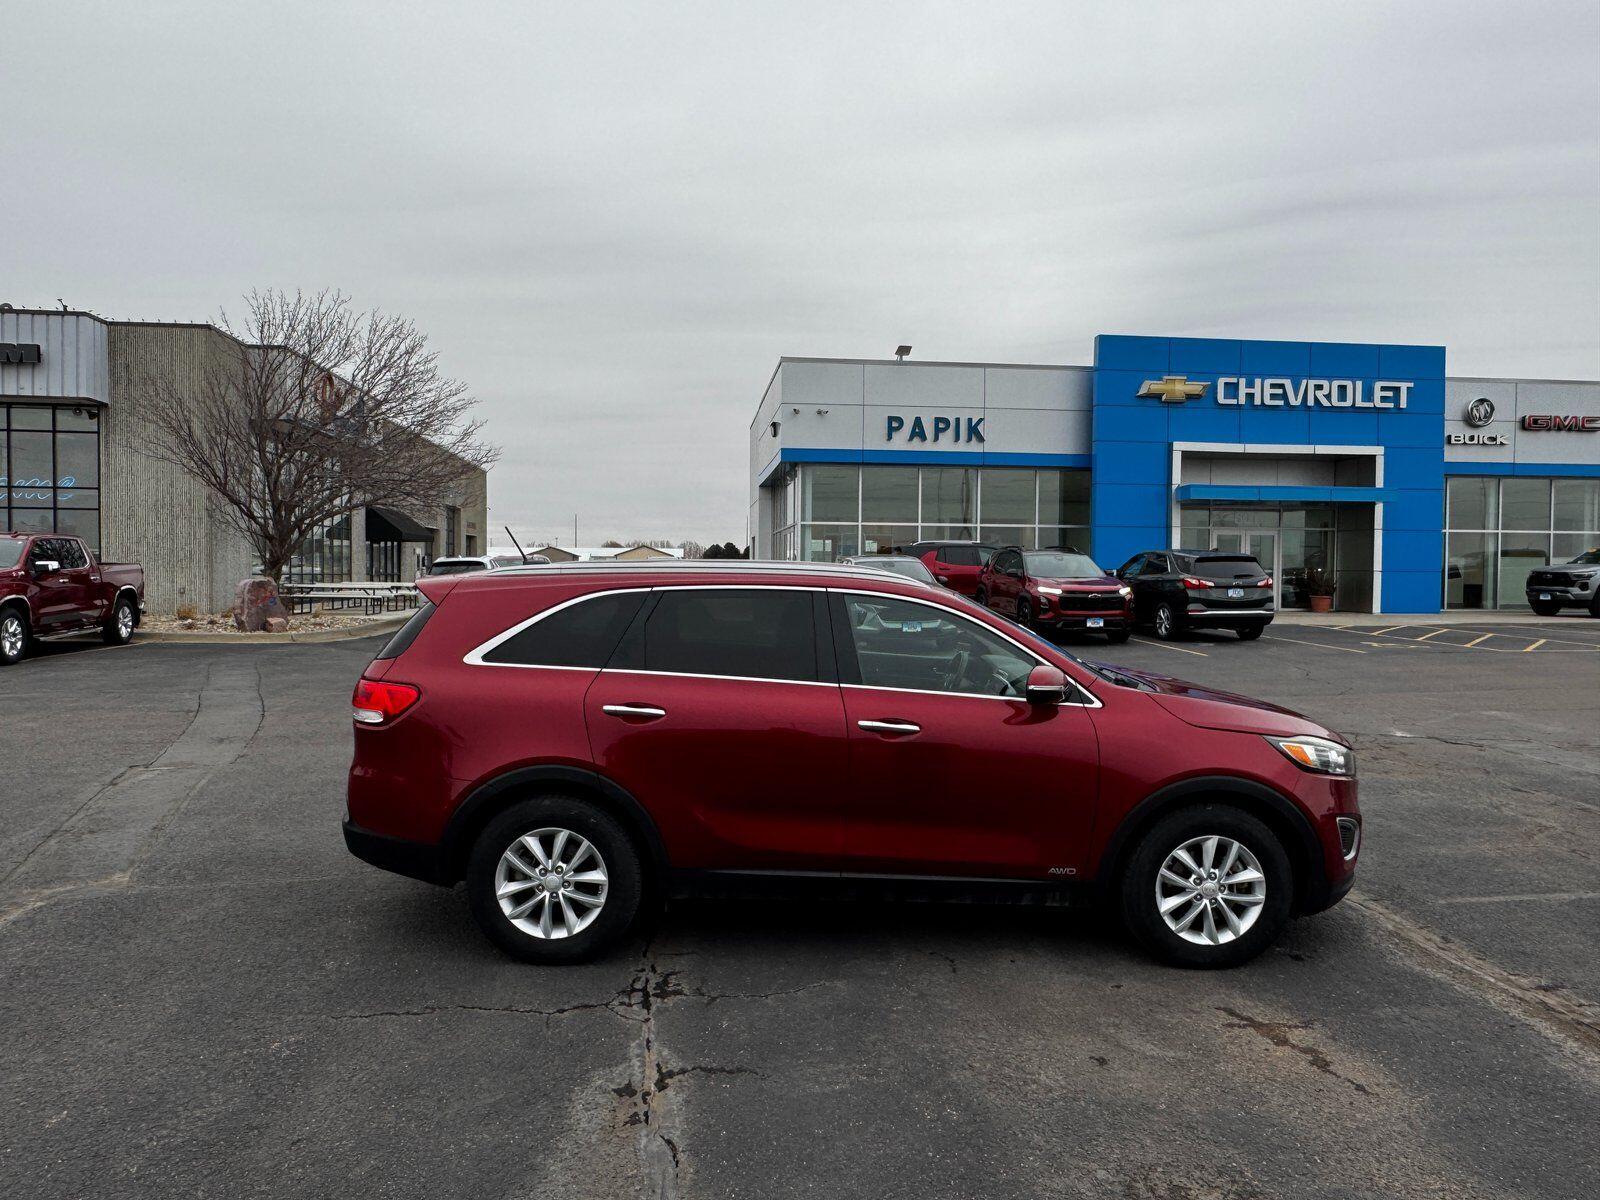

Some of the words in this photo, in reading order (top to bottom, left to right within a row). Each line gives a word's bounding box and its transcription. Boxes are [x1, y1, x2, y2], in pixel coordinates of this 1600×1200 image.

[1217, 377, 1414, 409] CHEVROLET
[886, 415, 985, 443] PAPIK
[1524, 415, 1600, 432] GMC
[1449, 433, 1509, 446] BUICK
[1048, 867, 1077, 875] AWD
